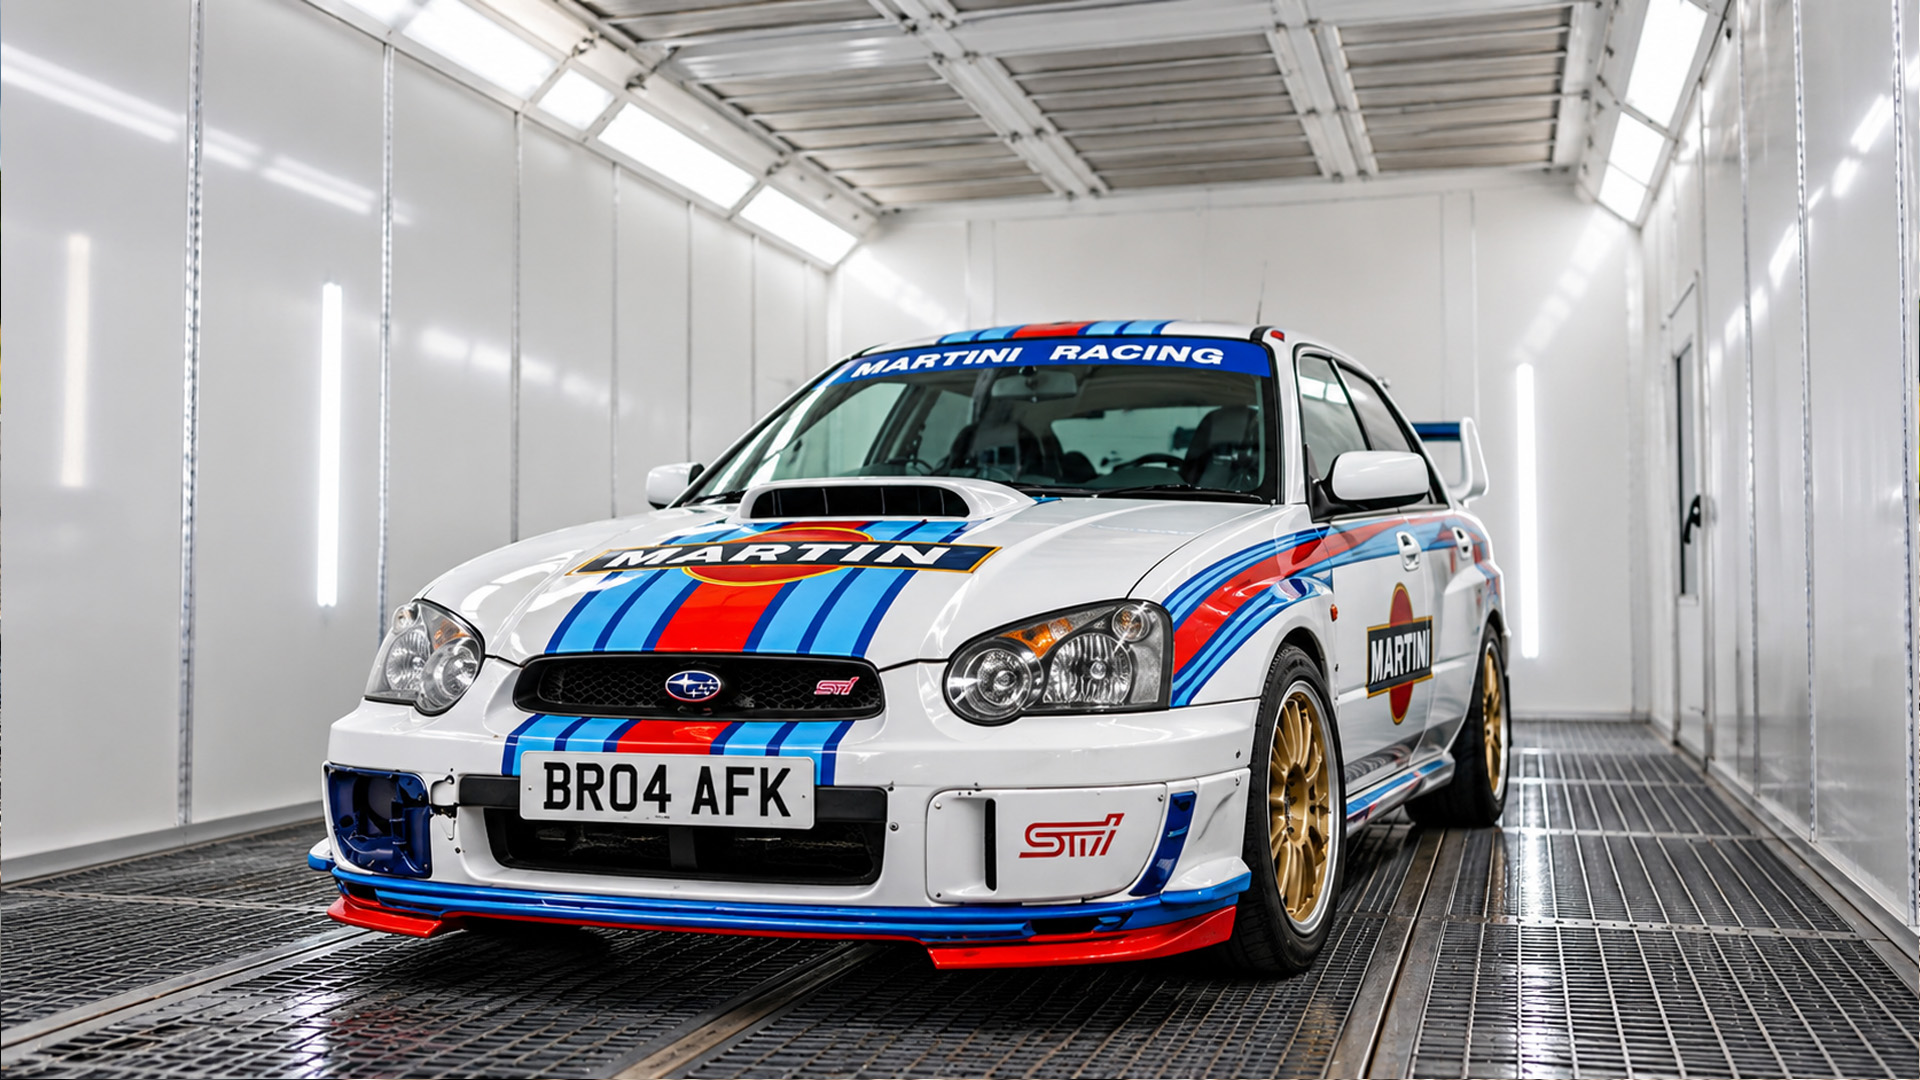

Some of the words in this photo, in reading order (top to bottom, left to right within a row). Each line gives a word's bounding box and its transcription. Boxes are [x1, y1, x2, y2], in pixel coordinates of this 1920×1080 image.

[850, 347, 1023, 379] MARTINI
[1049, 344, 1225, 366] RACING
[602, 542, 952, 568] MARTIN
[1370, 628, 1431, 685] MARTINI
[543, 761, 672, 813] BR04
[690, 765, 792, 818] AFK
